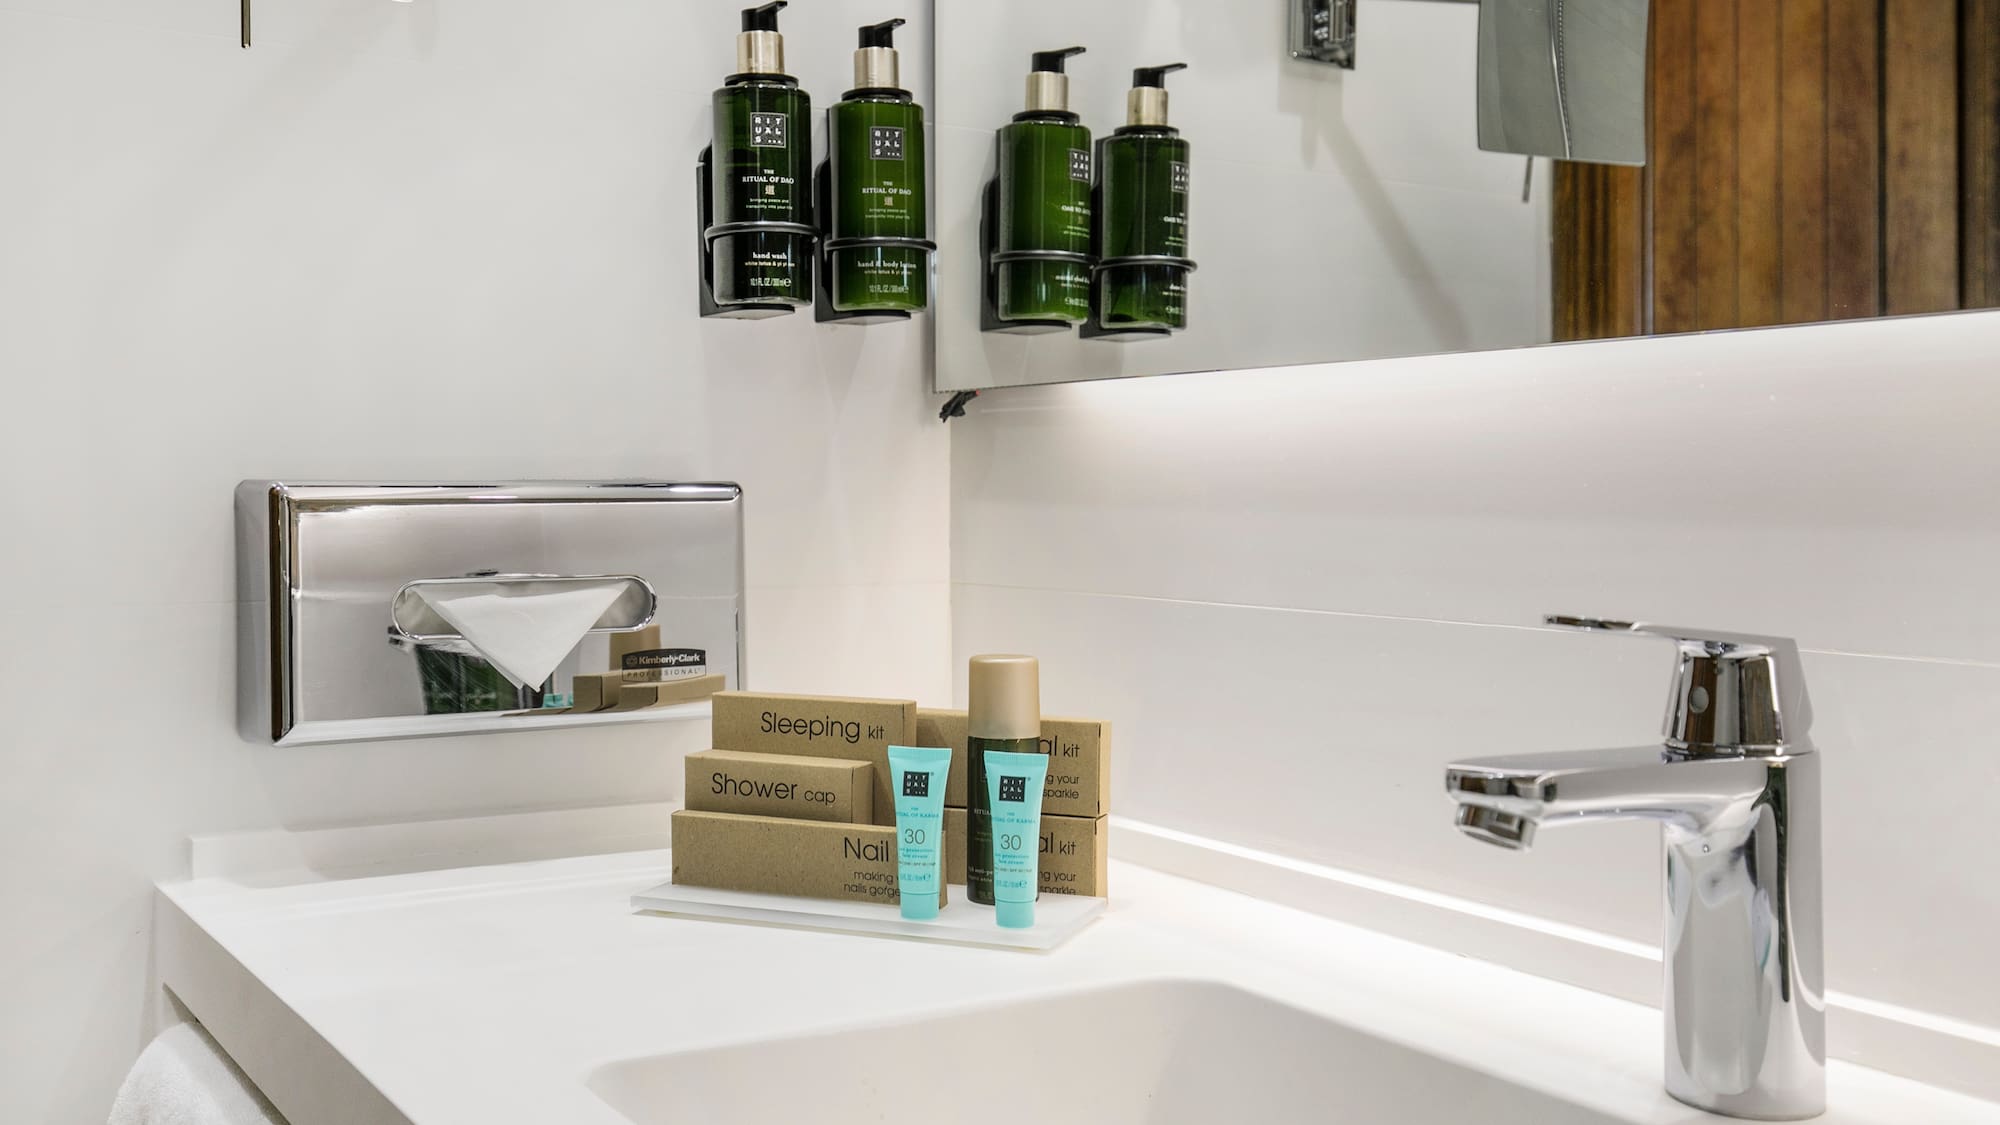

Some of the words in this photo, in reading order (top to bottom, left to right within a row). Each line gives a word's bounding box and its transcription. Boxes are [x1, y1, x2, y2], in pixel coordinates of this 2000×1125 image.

[883, 260, 899, 269] body
[760, 711, 860, 744] Sleeping
[868, 725, 885, 740] kit
[1063, 743, 1080, 758] kit
[1056, 775, 1080, 785] your
[711, 772, 798, 800] Shower
[804, 789, 836, 806] cap
[1043, 788, 1080, 800] sparkle
[904, 828, 925, 845] 30
[1000, 834, 1021, 851] 30
[844, 836, 889, 863] Nail
[1059, 840, 1076, 855] kit
[853, 871, 894, 886] making
[1053, 871, 1077, 882] your
[843, 883, 867, 894] nails
[869, 885, 900, 898] gorge
